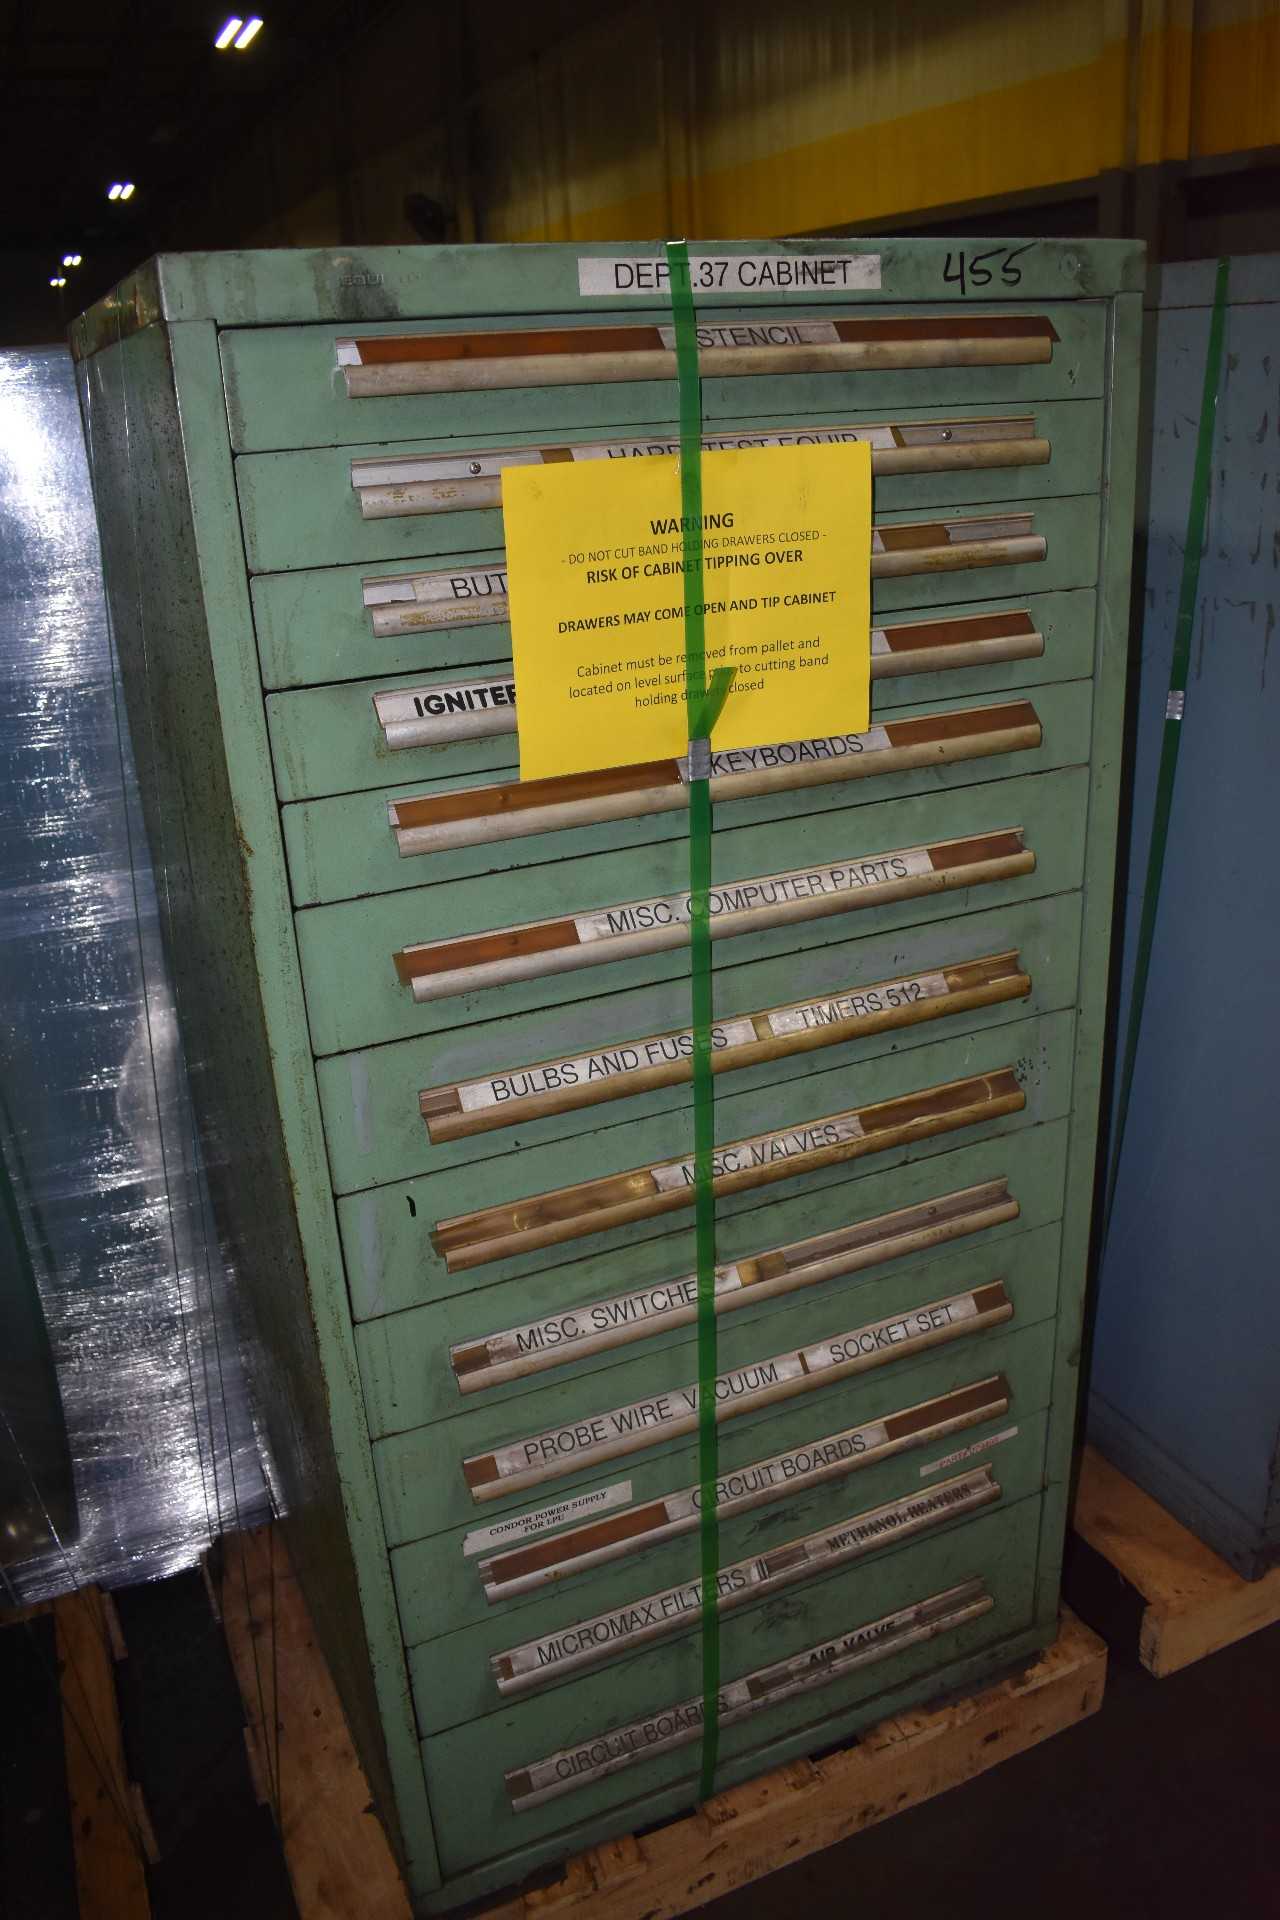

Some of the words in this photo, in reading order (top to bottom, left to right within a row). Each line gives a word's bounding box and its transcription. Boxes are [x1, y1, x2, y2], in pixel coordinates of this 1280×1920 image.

[738, 260, 852, 287] CABINET
[943, 241, 1038, 295] 455
[696, 325, 812, 349] STENCIL
[650, 512, 734, 535] WARNING
[568, 552, 585, 565] DO
[588, 549, 613, 563] NOT
[614, 547, 636, 560] CUT
[638, 543, 668, 557] BAND
[722, 533, 776, 548] DRAWERS
[778, 530, 820, 543] CLOSED
[586, 568, 618, 584] RISK
[621, 565, 640, 580] OF
[704, 552, 761, 570] TIPPING
[764, 549, 804, 564] OVER
[558, 615, 620, 634] DRAWERS
[623, 610, 651, 625] MAY
[729, 598, 758, 611] AND
[760, 596, 780, 609] TIP
[783, 591, 837, 607] CABINET
[569, 681, 613, 699] located
[616, 680, 631, 692] on
[634, 673, 661, 688] level
[739, 662, 751, 674] to
[754, 657, 796, 671] cutting
[799, 652, 829, 668] band
[577, 661, 623, 678] Cabinet
[626, 657, 655, 671] must
[658, 653, 673, 666] be
[729, 644, 758, 657] from
[761, 639, 795, 655] pallet
[798, 635, 820, 649] and
[635, 691, 678, 708] holding
[728, 677, 765, 694] closed
[710, 732, 865, 776] KEYBOARDS
[606, 902, 681, 934] MISC.
[830, 858, 908, 889] PARTS
[796, 992, 884, 1030] TIMERS
[885, 982, 926, 1013] 512
[490, 1062, 579, 1102] BULBS
[587, 1049, 640, 1080] AND
[645, 1027, 728, 1065] FUSS
[750, 1124, 840, 1168] VALVES
[515, 1316, 586, 1352] MISC.
[829, 1321, 912, 1364] SOCKET
[914, 1303, 953, 1332] SET
[523, 1419, 608, 1465] PROBE
[611, 1398, 673, 1434] WIRE
[692, 1466, 776, 1510] CRCUIT
[781, 1433, 867, 1478] BOARDS
[489, 1515, 533, 1536] CONDOR
[534, 1503, 570, 1522] POWER
[571, 1491, 608, 1510] SUPPLY
[523, 1520, 545, 1533] FOR
[537, 1603, 658, 1667] MICROMAX
[660, 1568, 746, 1618] FILTRS
[555, 1729, 639, 1779] CIRCUIT
